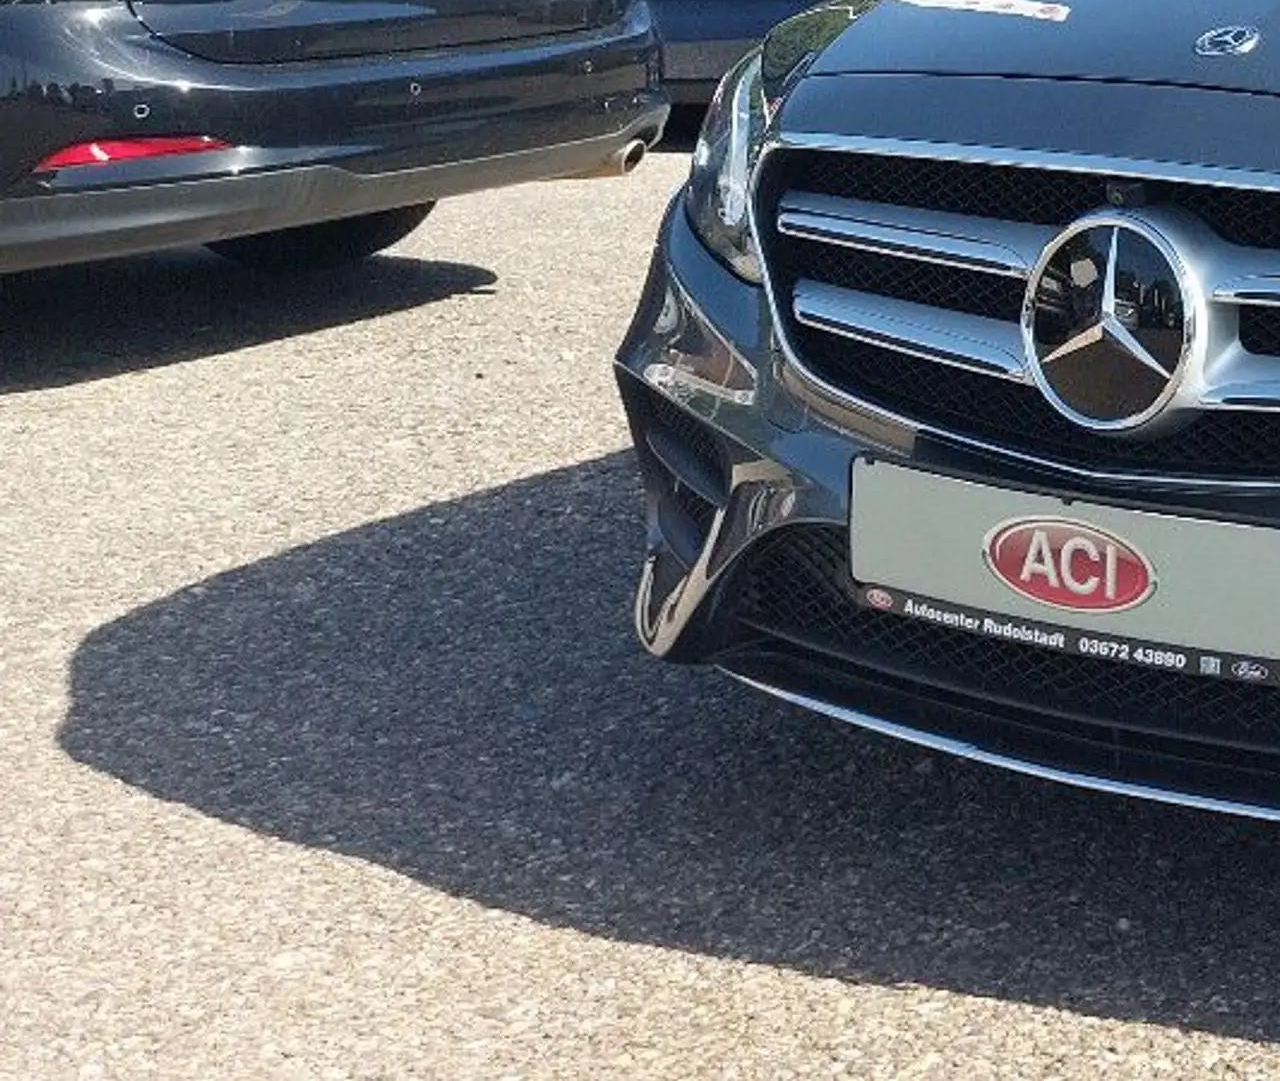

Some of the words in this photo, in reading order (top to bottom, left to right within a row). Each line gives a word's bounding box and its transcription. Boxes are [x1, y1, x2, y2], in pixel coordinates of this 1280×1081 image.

[1019, 529, 1119, 600] ACI
[904, 598, 980, 629] Autocenter
[984, 617, 1065, 649] Rudolstadt
[1079, 636, 1130, 661] 03672
[1132, 646, 1188, 669] 43890
